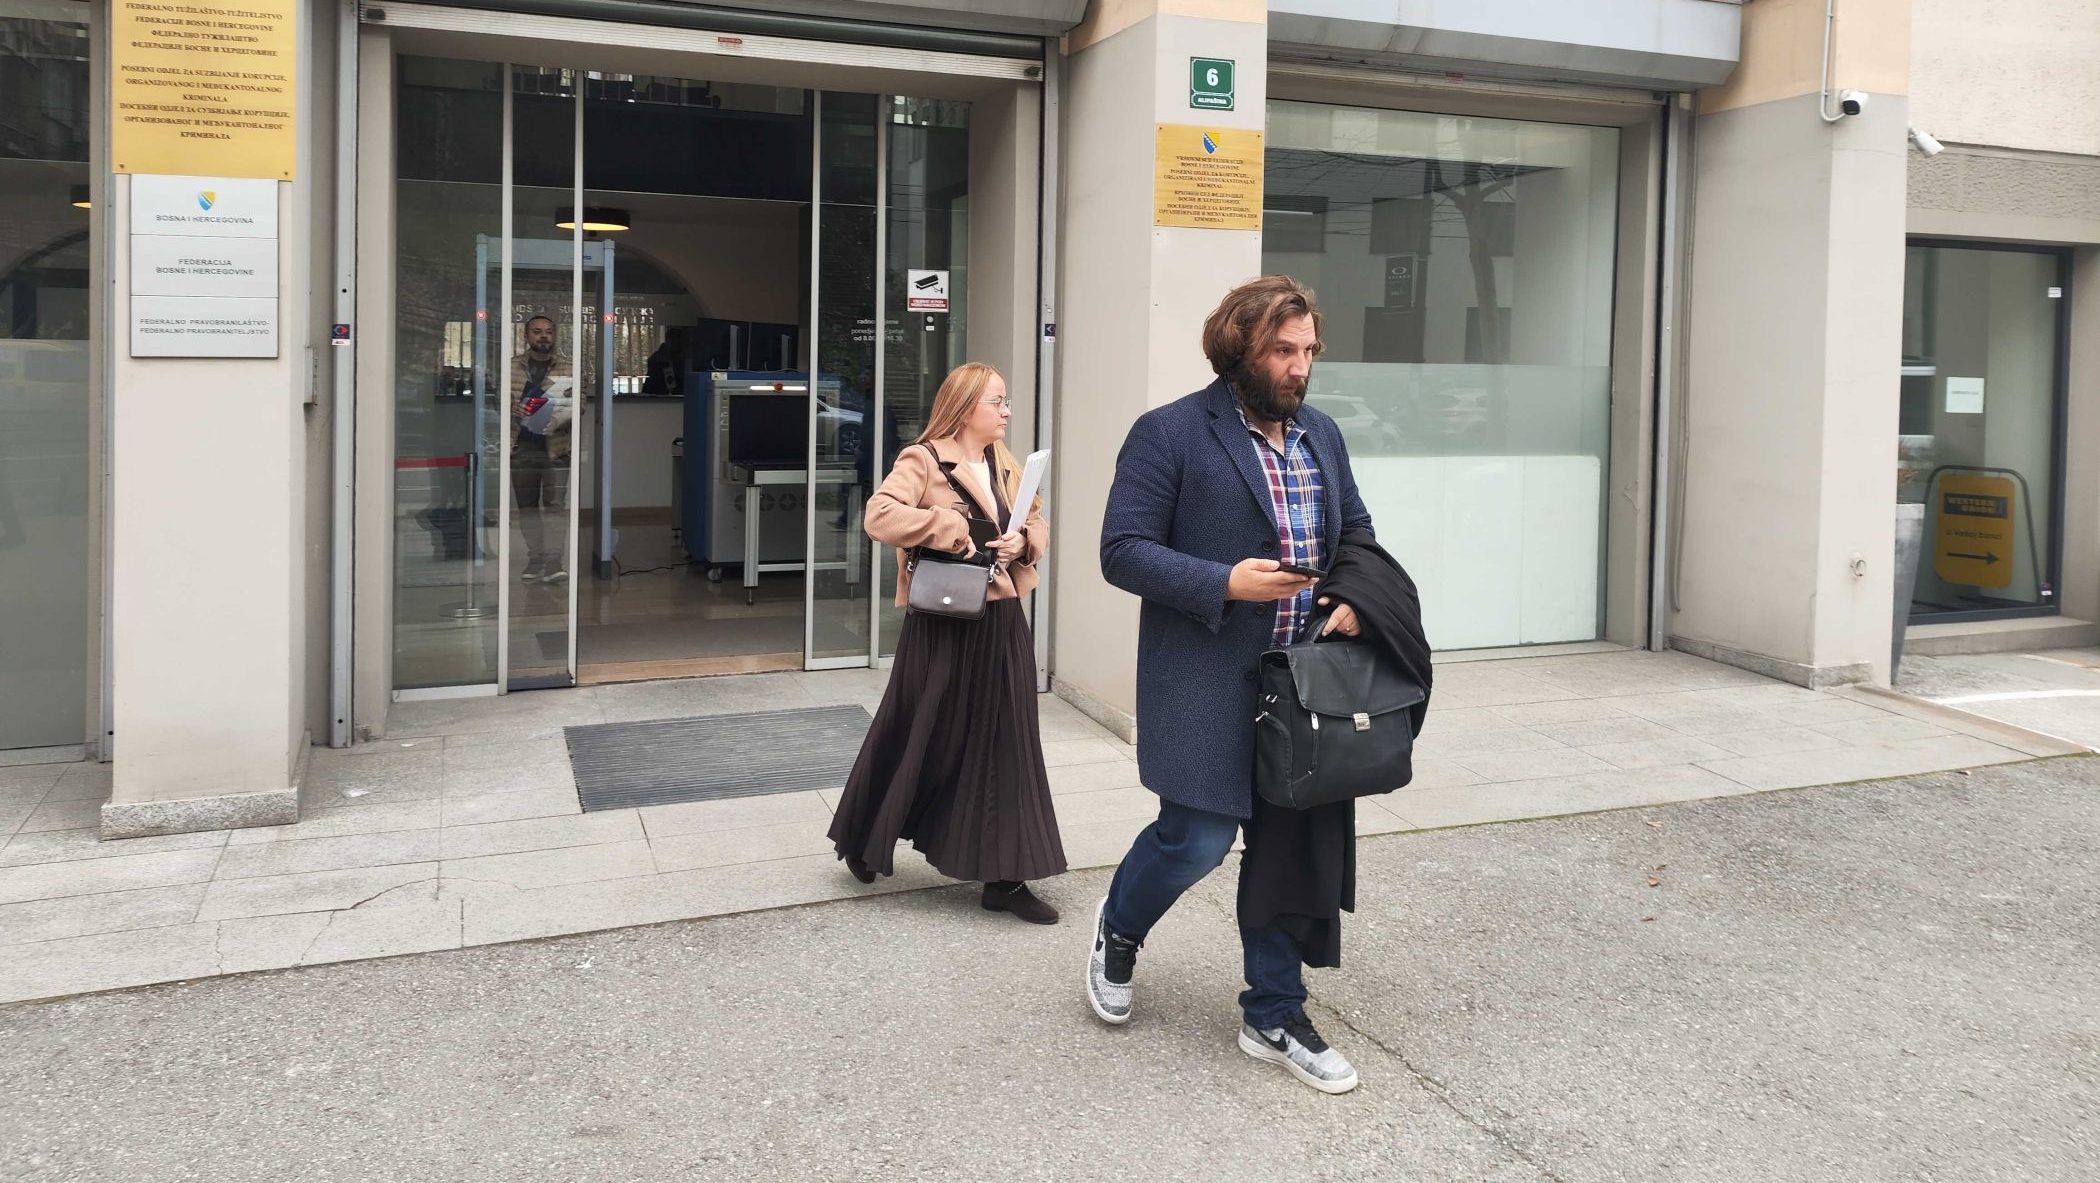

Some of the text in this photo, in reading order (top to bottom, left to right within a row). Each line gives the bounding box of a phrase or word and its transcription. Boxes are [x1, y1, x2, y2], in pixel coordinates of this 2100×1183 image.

[126, 3, 174, 11] FEDERALNO
[135, 16, 184, 25] FEDERACIJE
[186, 19, 211, 27] BOSNE
[218, 22, 273, 31] HERCEGOVINE
[121, 65, 155, 73] POSEBNI
[156, 67, 180, 75] ODJEL
[195, 70, 241, 78] SUZBIJANJE
[1206, 68, 1219, 86] 6
[126, 78, 195, 88] ORGANIZOVANOG
[182, 94, 228, 102] KRIMINALA
[156, 214, 186, 222] BOSNA
[192, 216, 254, 224] HERCEGOVINA
[178, 258, 232, 266] FEDERACIJA
